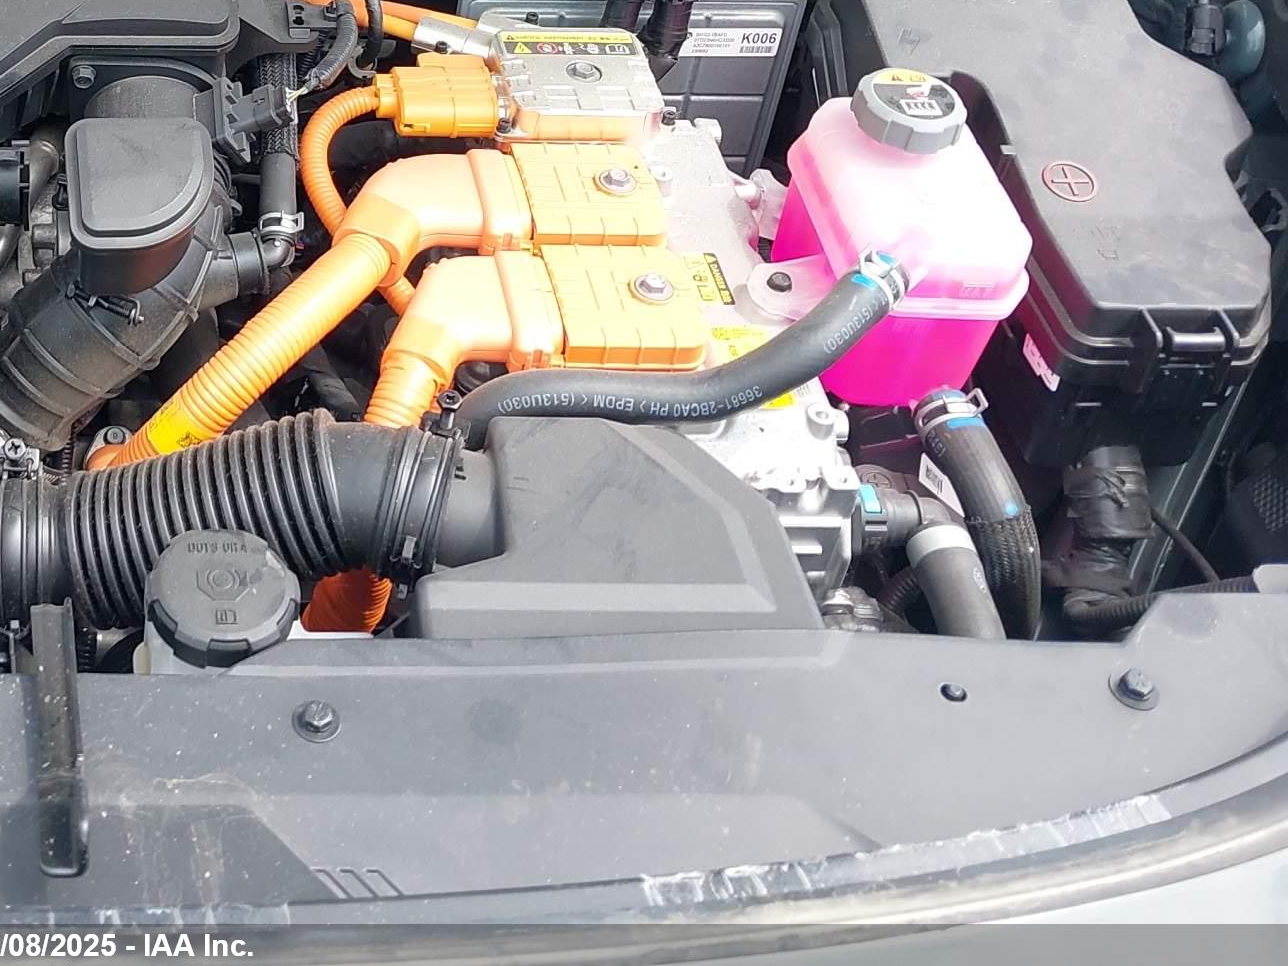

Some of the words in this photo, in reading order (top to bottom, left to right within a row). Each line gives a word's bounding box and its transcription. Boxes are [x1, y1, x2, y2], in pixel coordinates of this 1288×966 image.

[740, 32, 777, 44] K006
[823, 305, 873, 354] (513U030)
[497, 392, 575, 414] (513U030)
[593, 395, 634, 411] EPDM
[650, 403, 669, 416] PH
[673, 385, 763, 417] 36681-2BCA0
